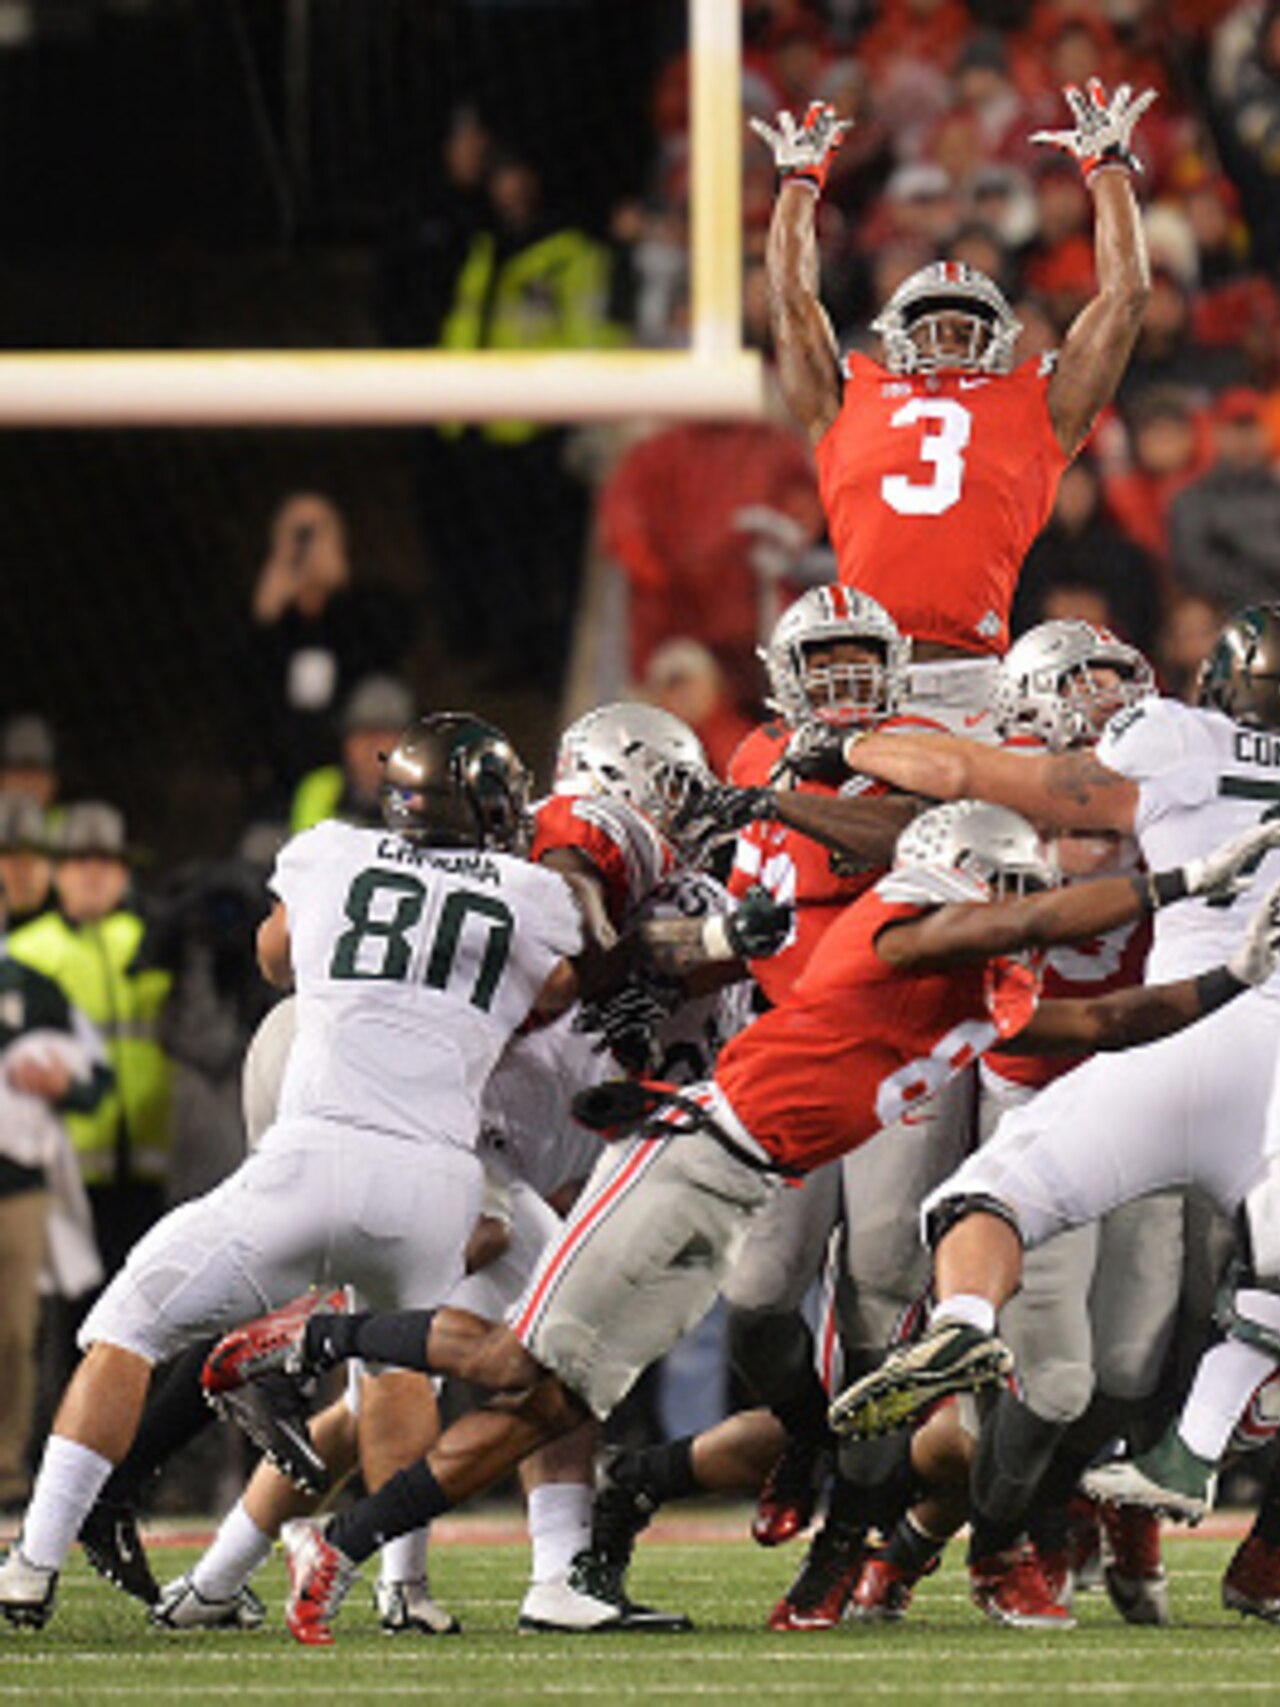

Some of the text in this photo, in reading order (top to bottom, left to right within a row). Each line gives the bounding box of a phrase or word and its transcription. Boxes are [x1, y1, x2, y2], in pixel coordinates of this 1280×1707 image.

[880, 397, 972, 515] 3
[329, 866, 514, 1014] 80
[875, 1019, 998, 1129] 8
